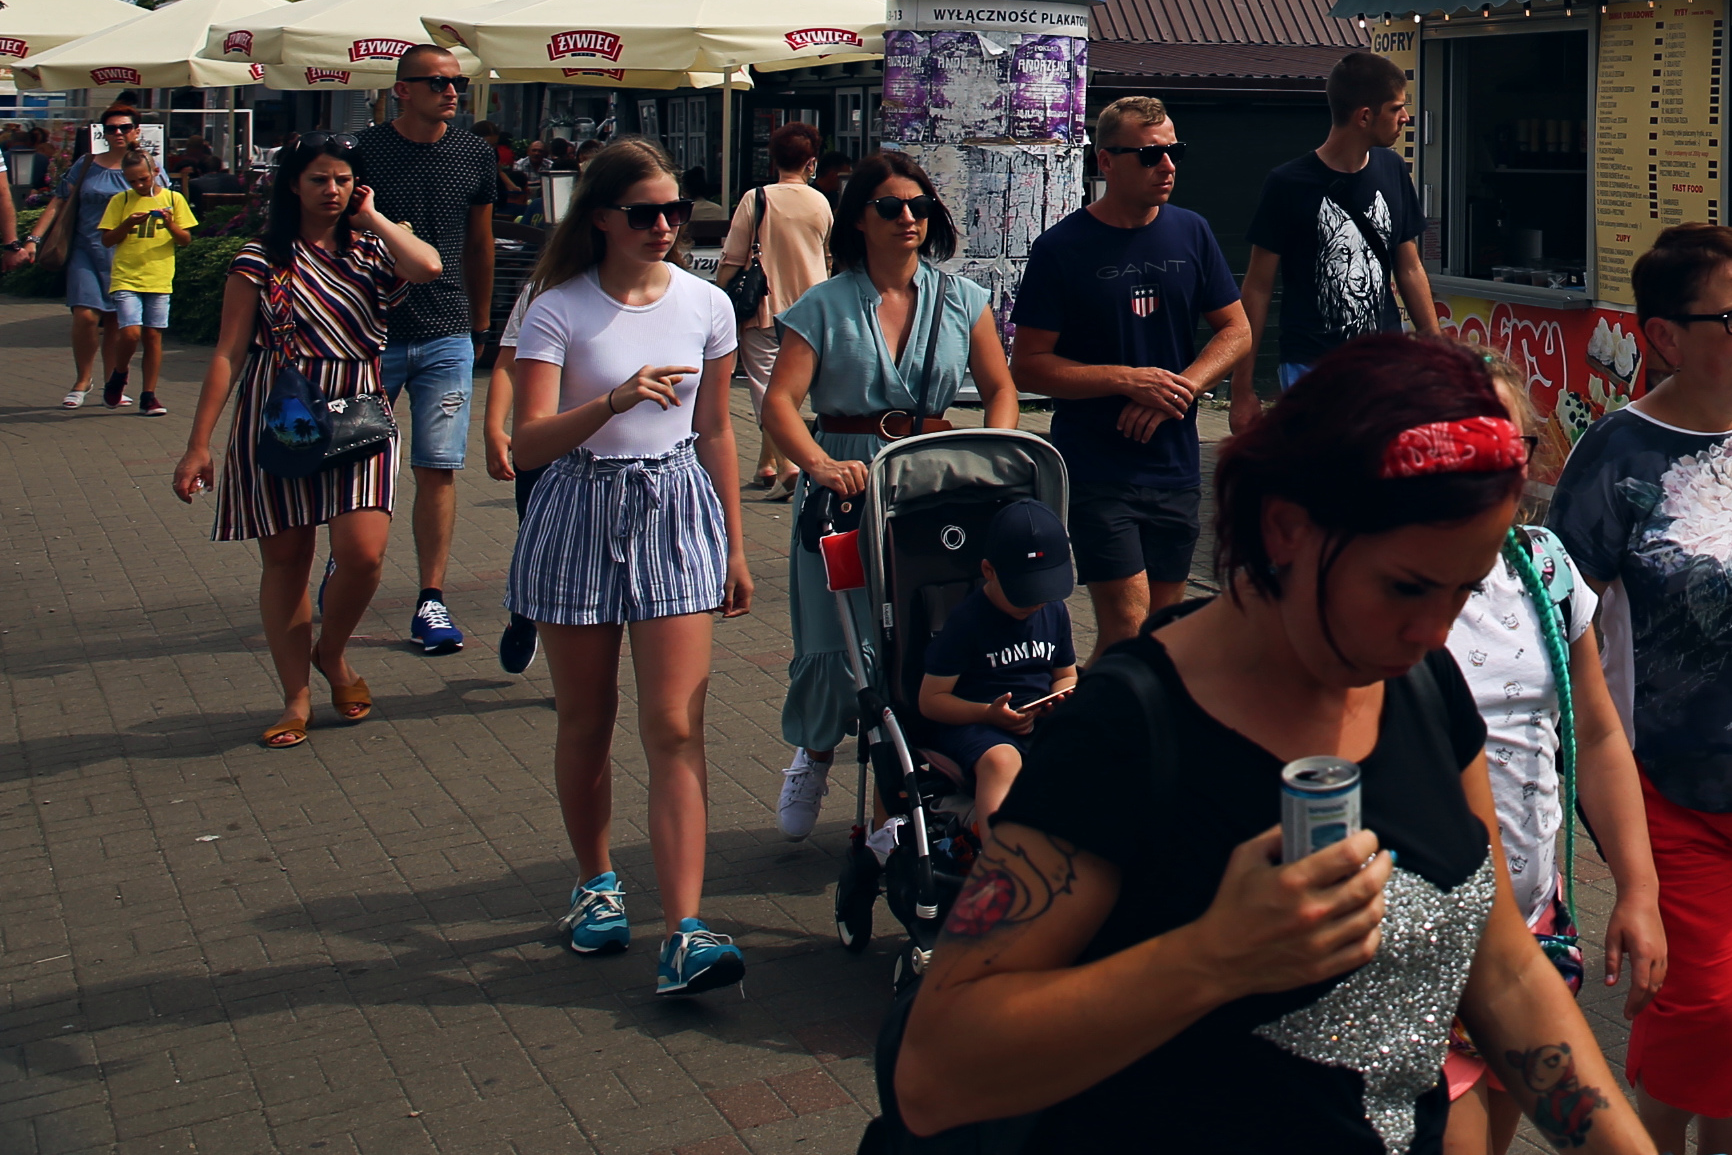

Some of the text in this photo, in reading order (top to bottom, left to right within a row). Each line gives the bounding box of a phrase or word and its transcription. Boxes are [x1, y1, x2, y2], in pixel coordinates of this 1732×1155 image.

[933, 8, 1037, 25] WYŁĄCZNOŚĆ
[0, 39, 21, 53] IEC
[557, 32, 614, 55] ŻYWIEC
[1373, 30, 1415, 53] GOFRY
[98, 67, 134, 81] ŻYWIEC
[1672, 184, 1686, 193] FAST
[1616, 234, 1631, 242] ZUPY
[1096, 259, 1186, 279] GANT
[986, 640, 1056, 668] TOMMY
